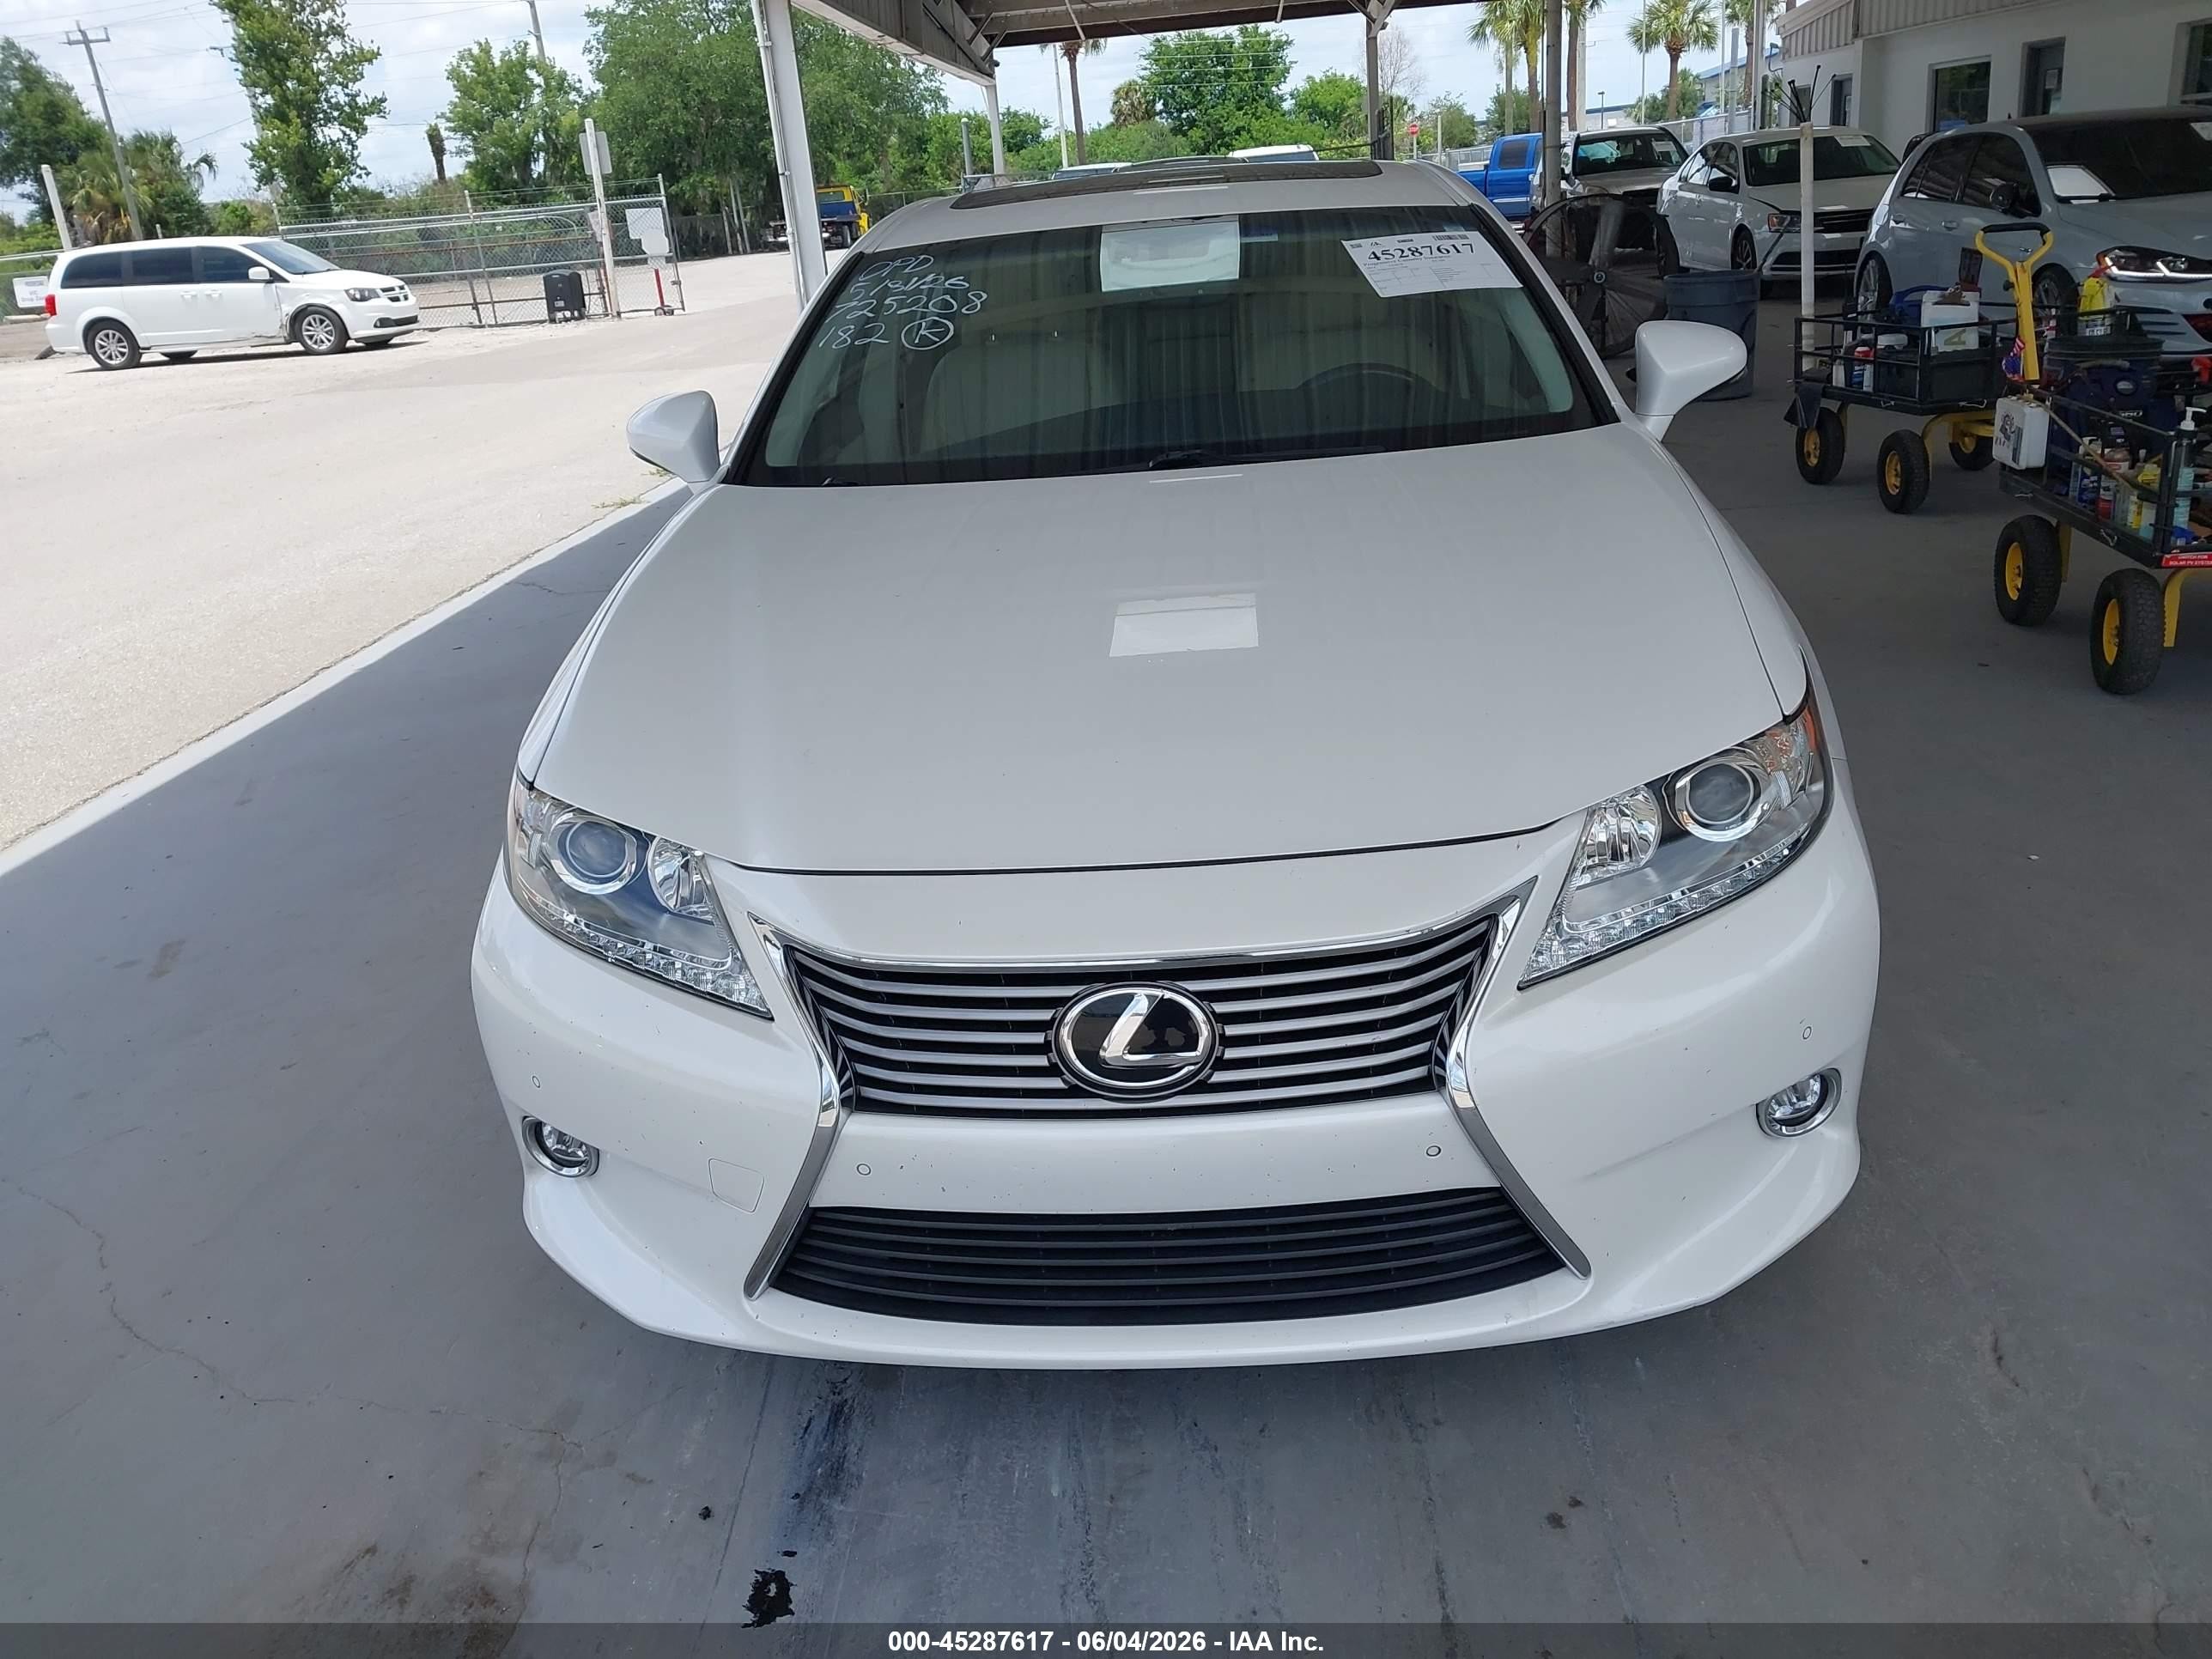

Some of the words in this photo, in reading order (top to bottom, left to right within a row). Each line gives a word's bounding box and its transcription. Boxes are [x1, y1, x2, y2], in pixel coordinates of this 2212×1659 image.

[1368, 243, 1474, 261] 45287617
[824, 290, 988, 324] 725208
[818, 322, 890, 349] 182
